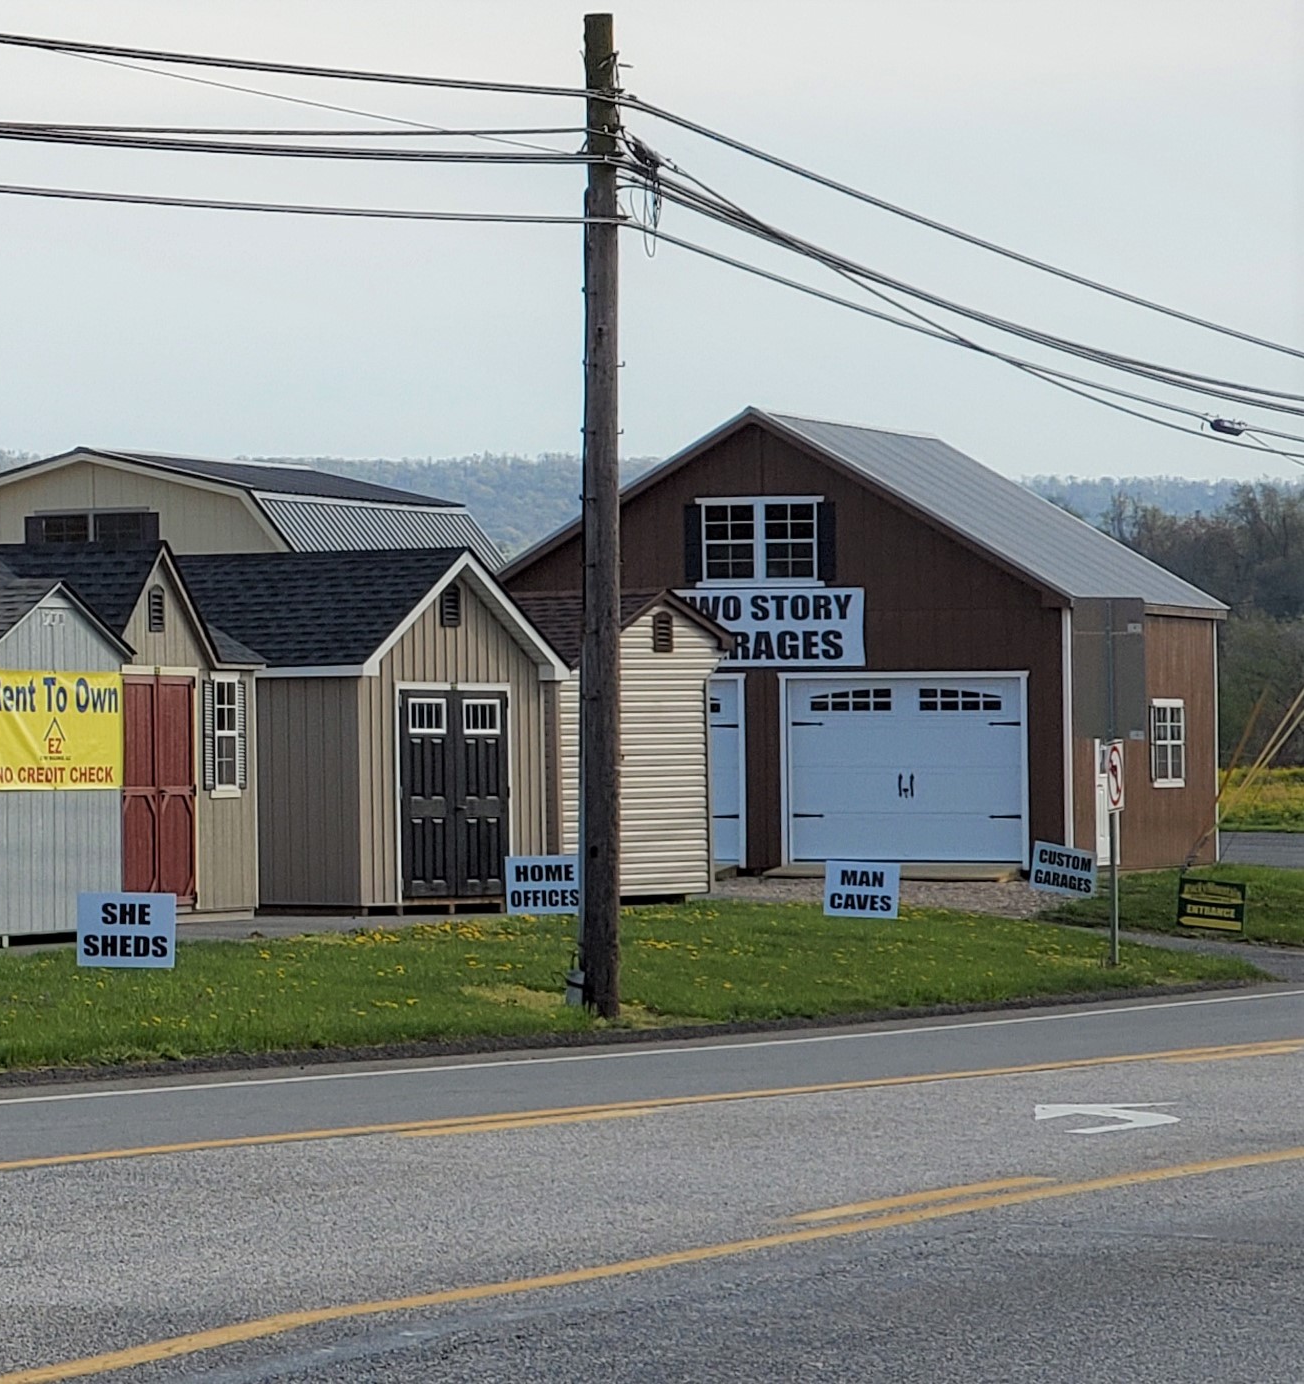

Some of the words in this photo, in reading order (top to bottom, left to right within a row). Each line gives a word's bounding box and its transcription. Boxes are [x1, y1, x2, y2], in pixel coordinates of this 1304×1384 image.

[683, 596, 742, 622] WO
[750, 594, 852, 621] STORY
[724, 630, 843, 660] RAGES
[43, 677, 68, 713] To
[76, 677, 118, 713] Own
[48, 738, 63, 754] EZ
[18, 767, 66, 784] CREDIT
[70, 766, 113, 783] CHECK
[1039, 849, 1092, 873] CUSTOM
[515, 864, 575, 882] HOME
[840, 869, 884, 888] MAN
[1034, 869, 1092, 893] GARAGES
[510, 889, 579, 908] OFFICES
[829, 893, 892, 912] CAVES
[101, 902, 151, 925] SHE
[83, 934, 168, 958] SHEDS
